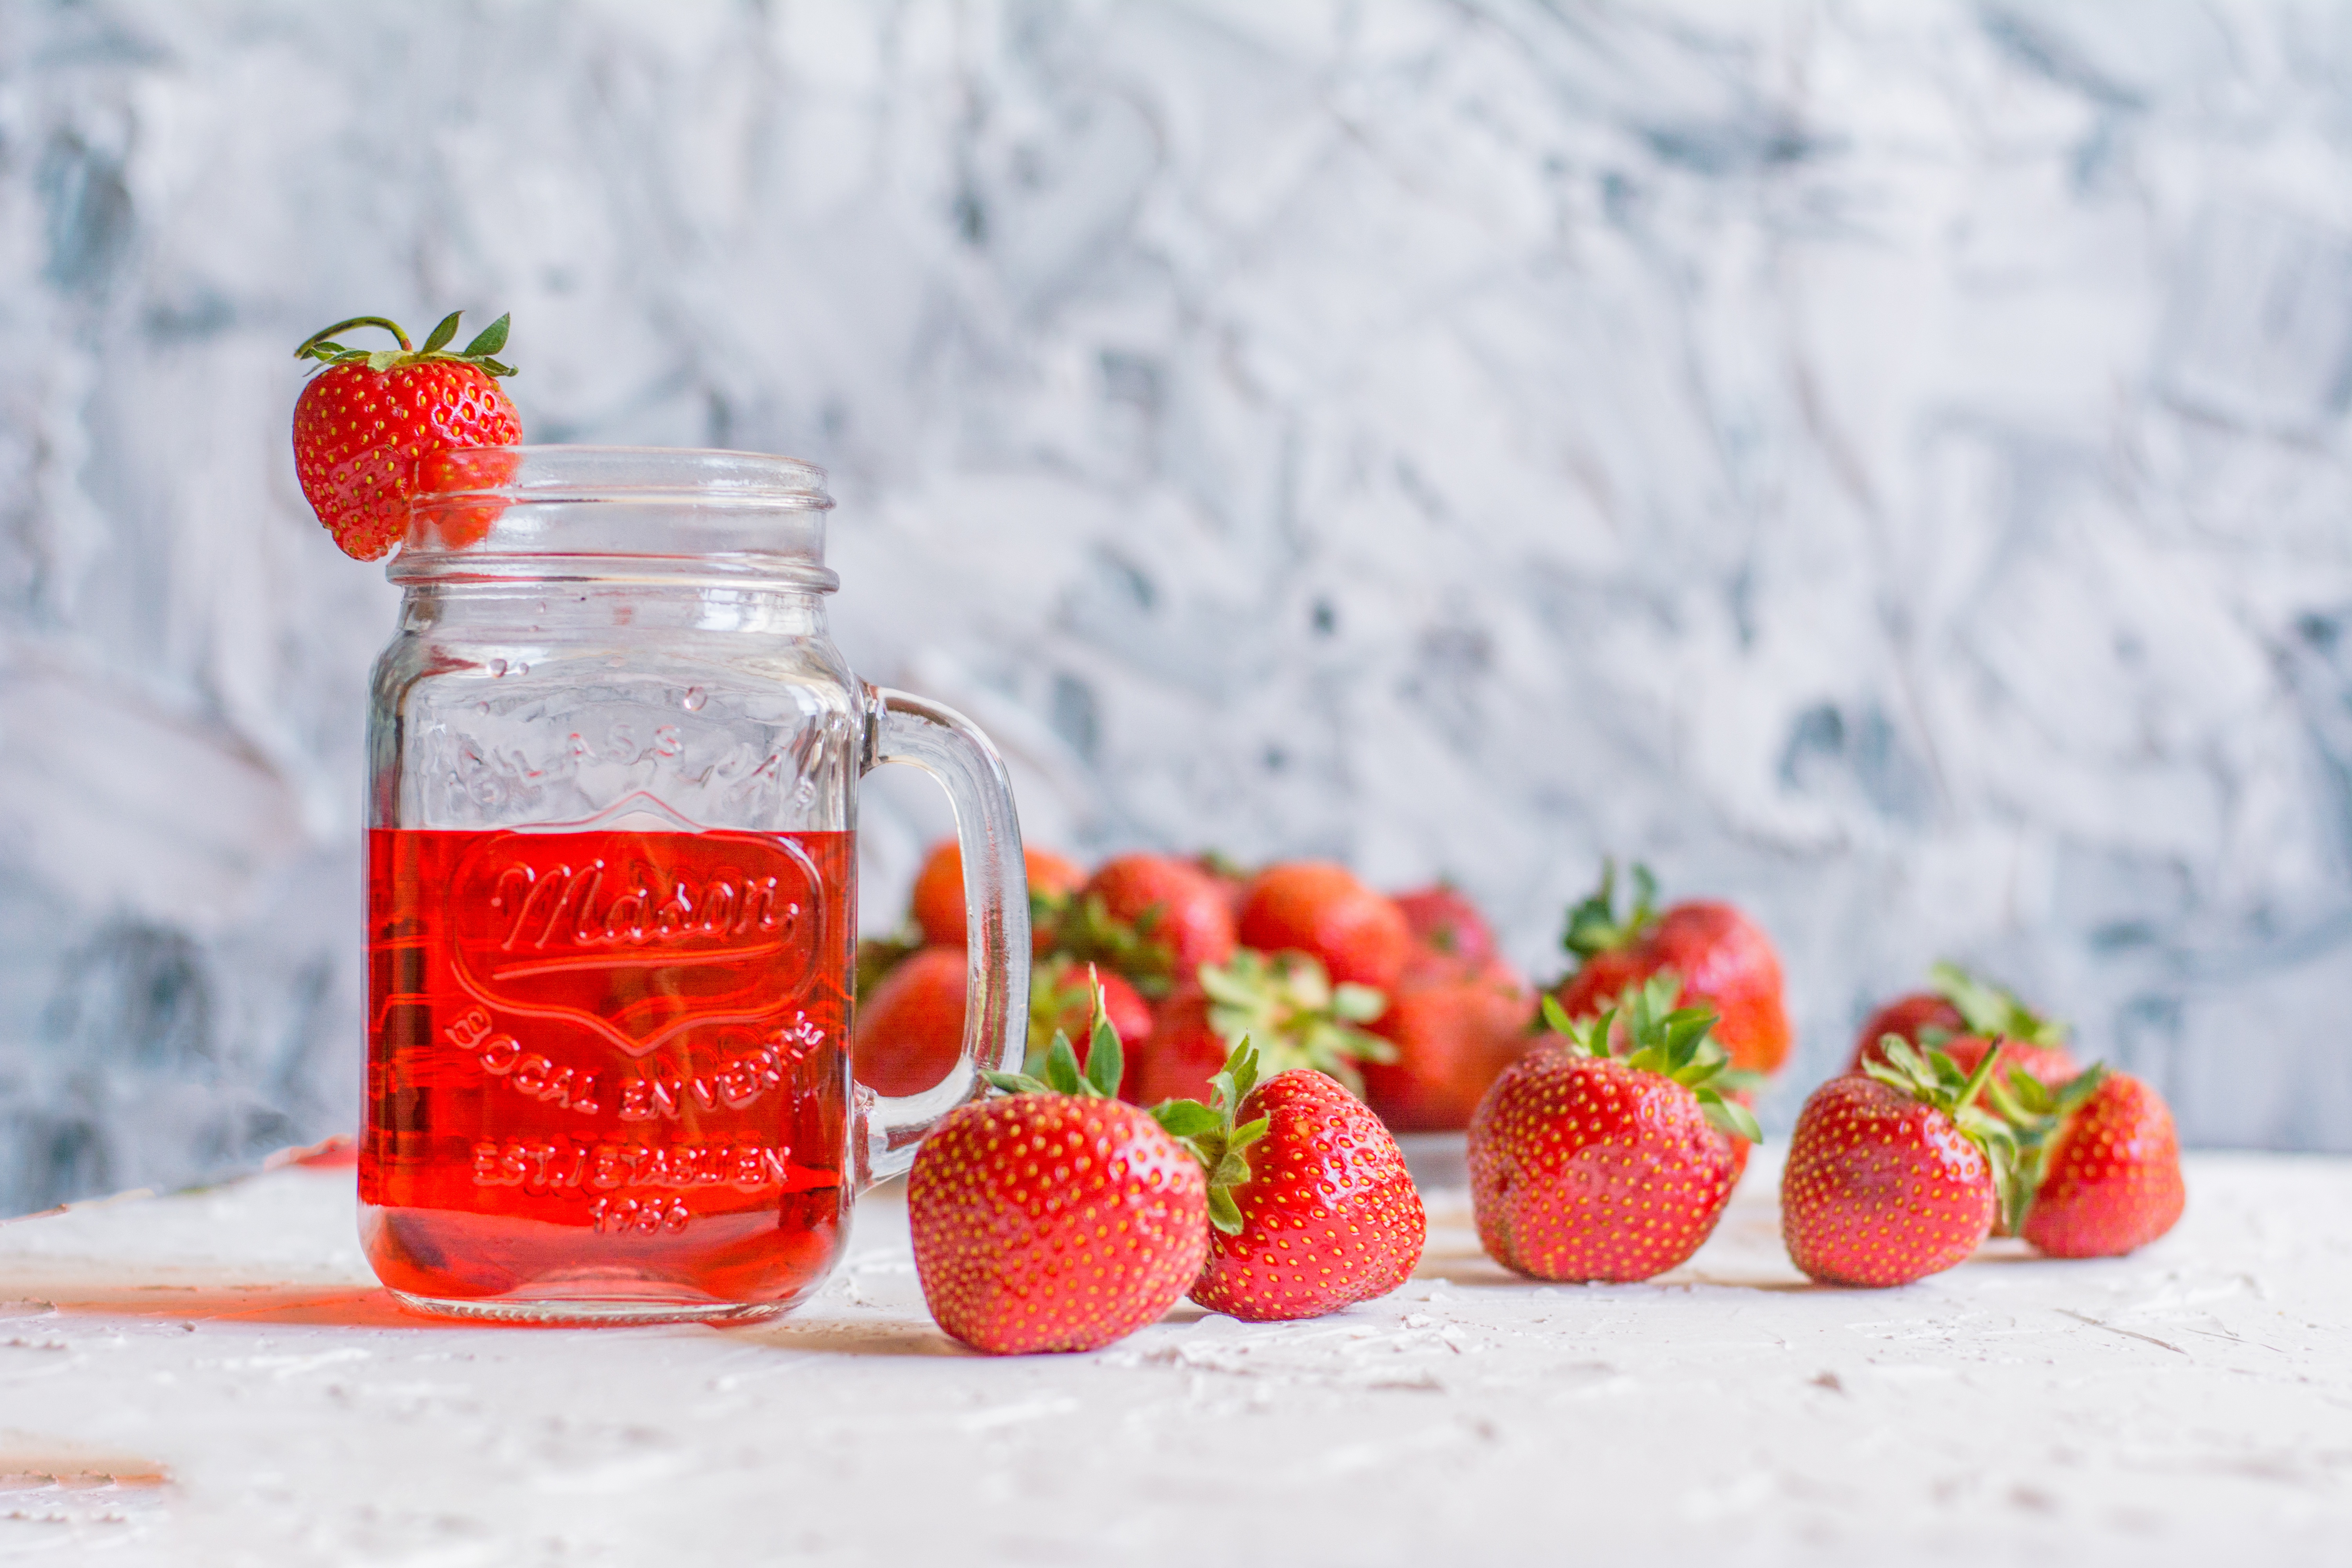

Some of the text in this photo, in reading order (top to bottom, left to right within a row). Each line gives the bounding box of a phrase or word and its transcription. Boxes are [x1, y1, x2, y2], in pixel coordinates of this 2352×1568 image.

[490, 858, 800, 950] Mason
[444, 1004, 600, 1115] BOCAL
[619, 1077, 681, 1121] EN
[737, 1145, 789, 1192] EN
